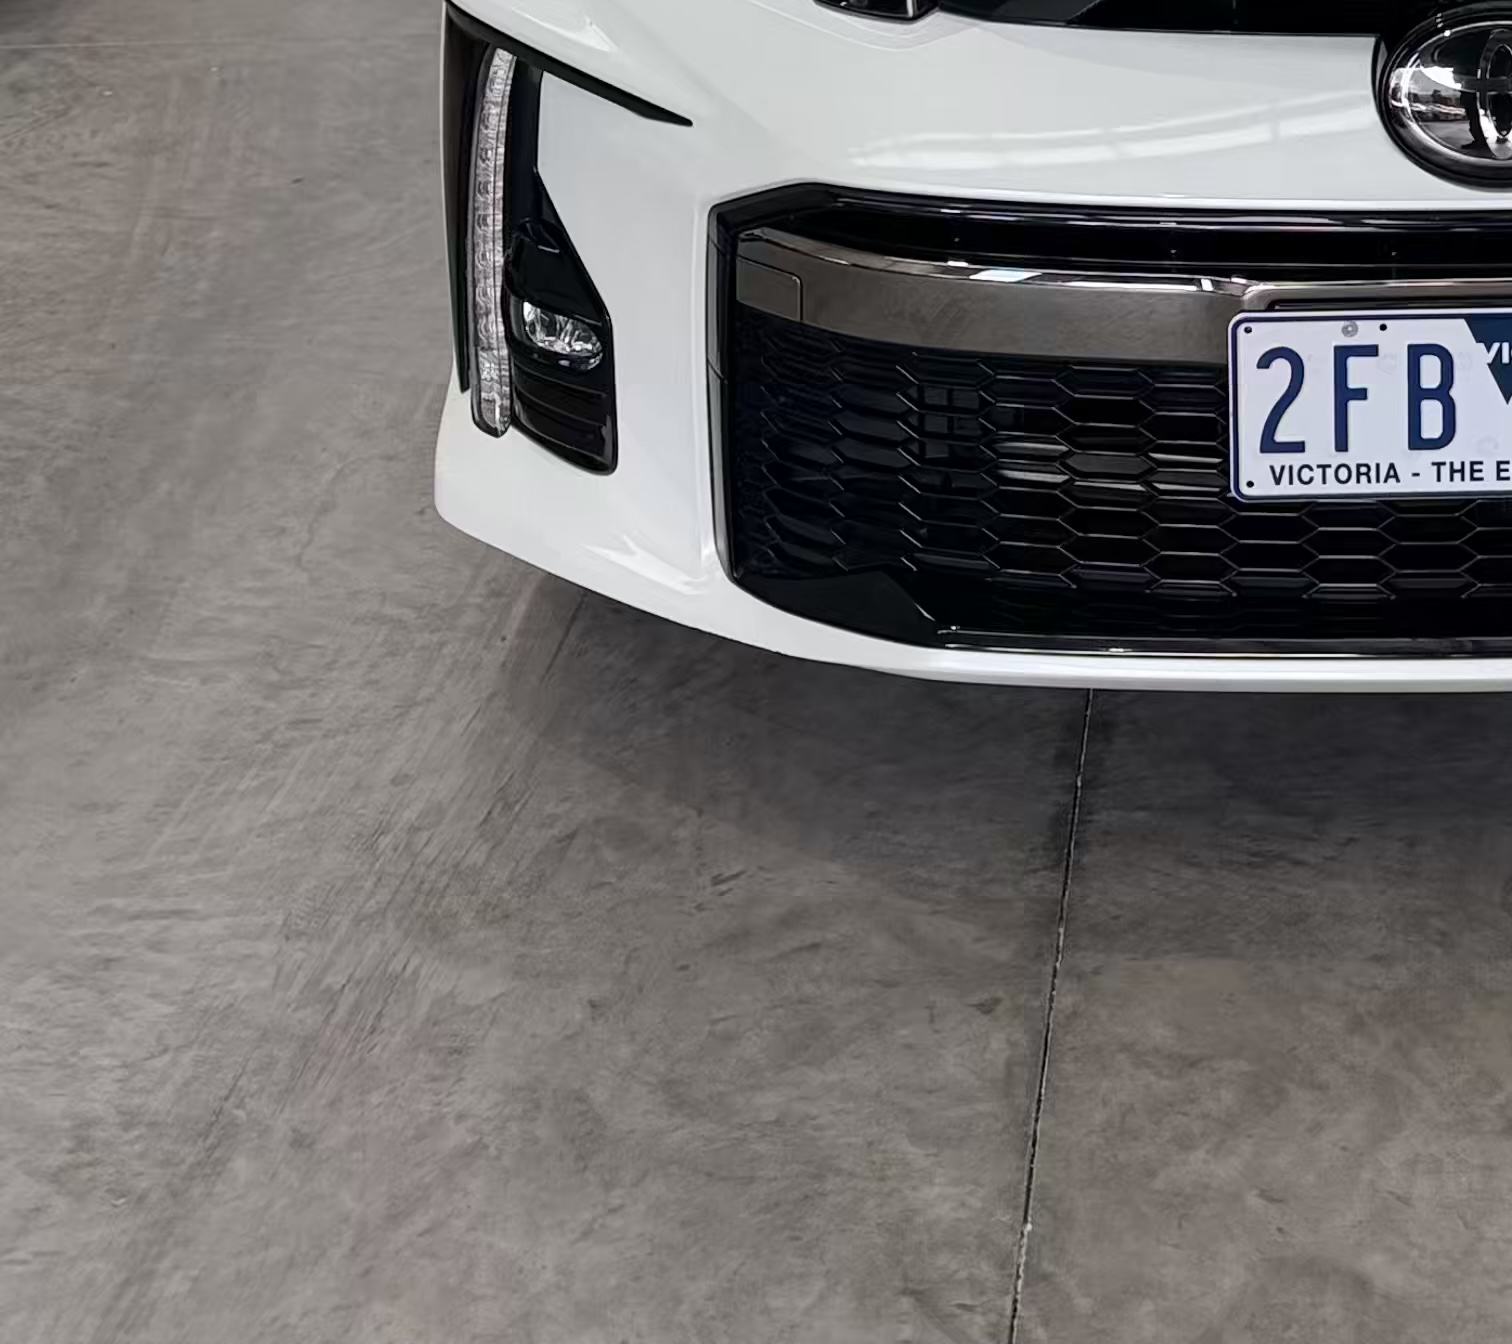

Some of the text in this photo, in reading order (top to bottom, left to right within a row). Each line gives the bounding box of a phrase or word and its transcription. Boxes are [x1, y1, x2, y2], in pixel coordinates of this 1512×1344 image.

[1255, 342, 1458, 454] 2FB
[1268, 461, 1401, 486] VICTORIA
[1432, 460, 1485, 483] THE
